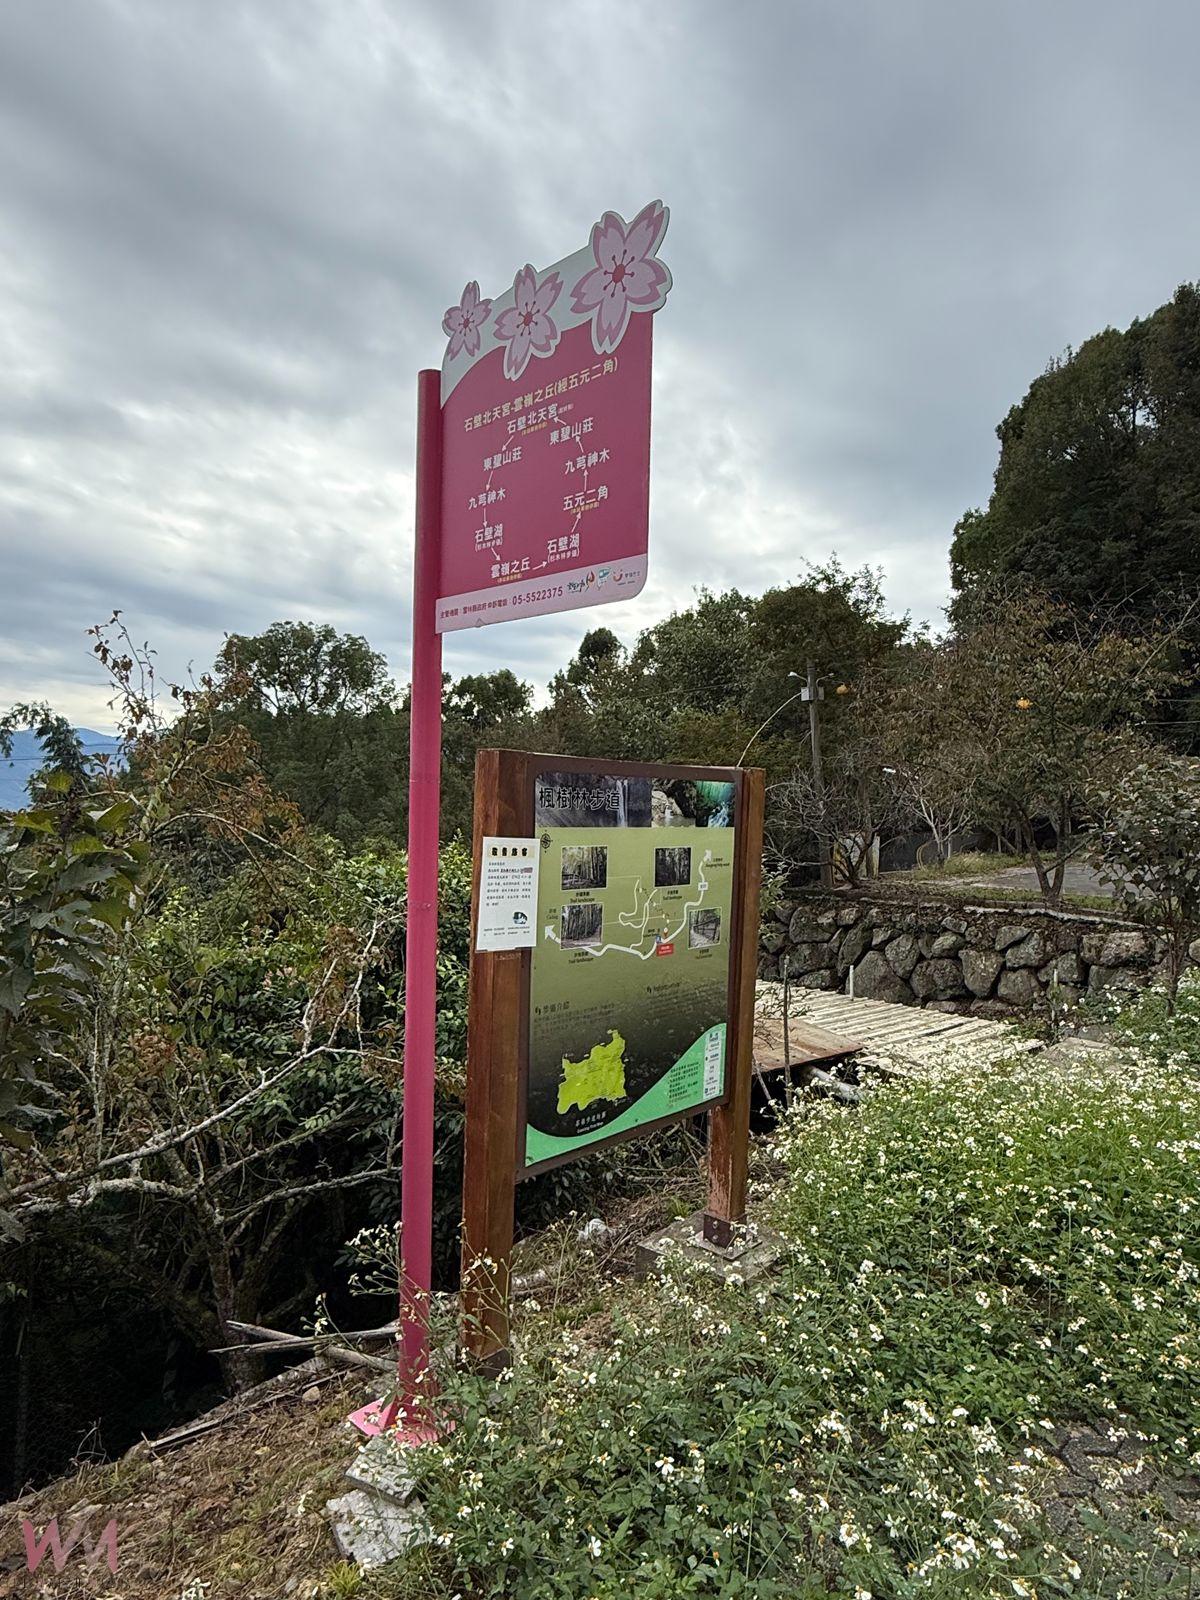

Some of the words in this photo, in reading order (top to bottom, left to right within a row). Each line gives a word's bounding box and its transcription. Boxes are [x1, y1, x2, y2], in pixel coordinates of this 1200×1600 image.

[507, 403, 558, 435] 石壁北天宮
[562, 485, 609, 512] 五元二角
[547, 533, 580, 553] 石壁湖
[512, 586, 563, 606] 05-5522375
[539, 786, 621, 811] 楓樹林步道
